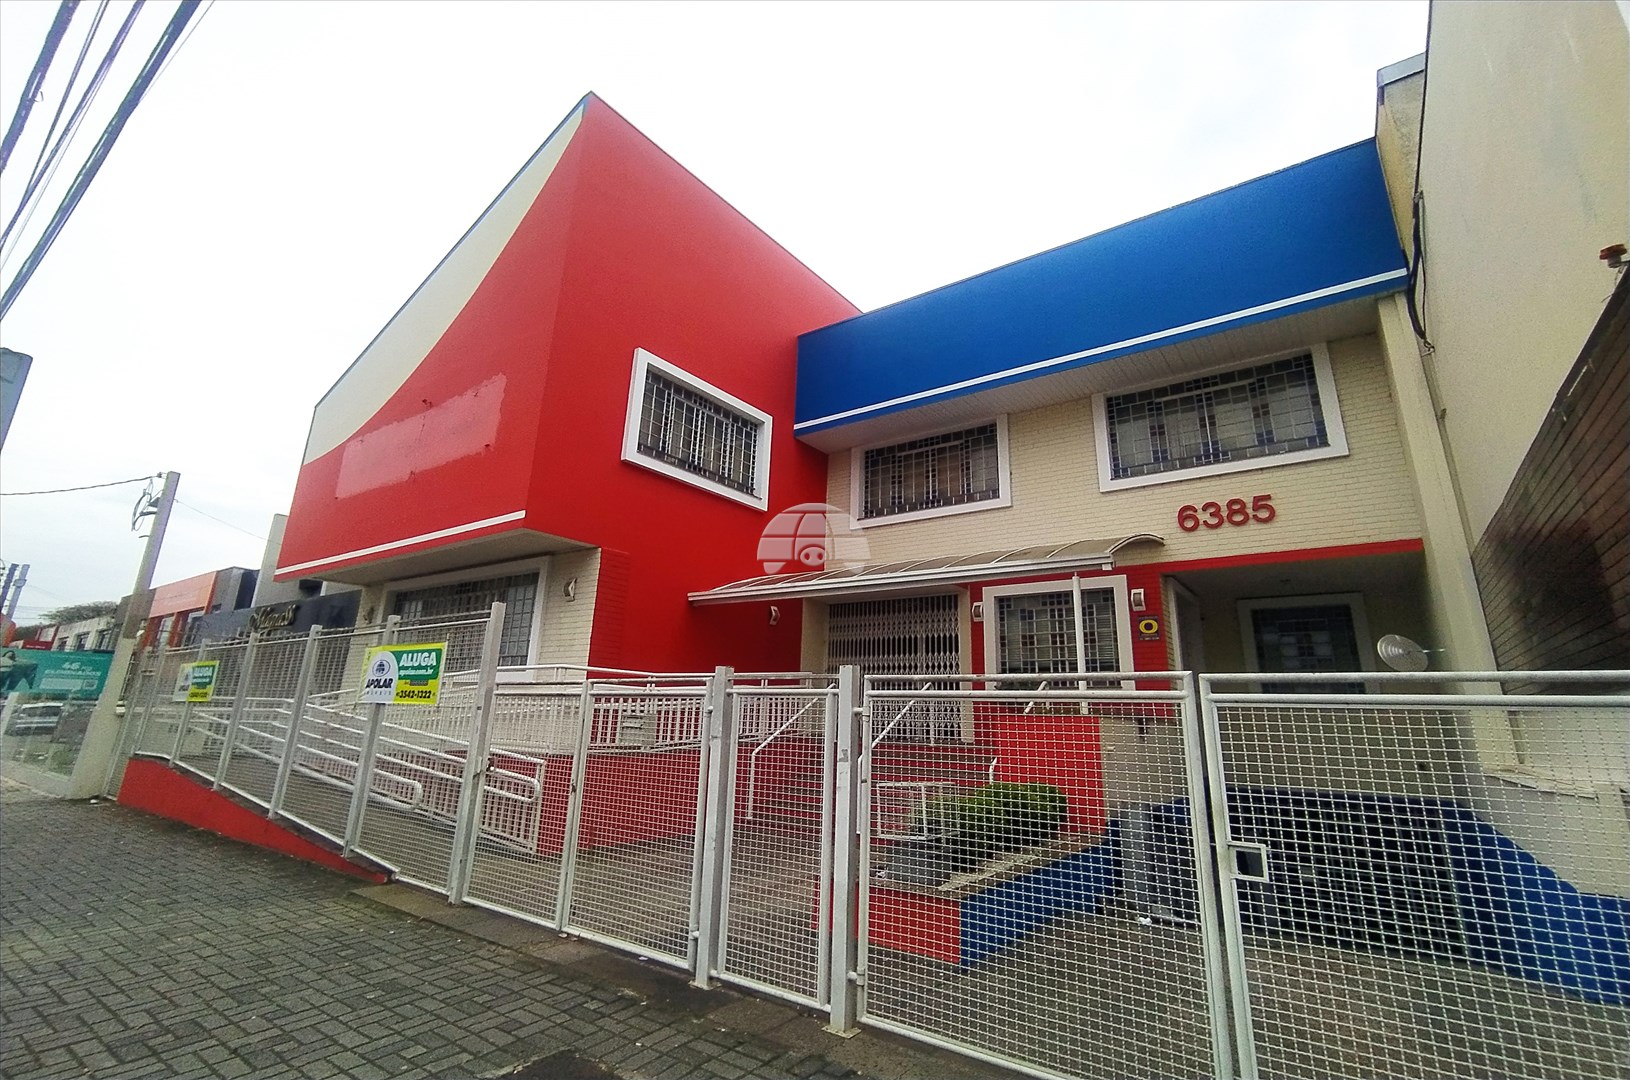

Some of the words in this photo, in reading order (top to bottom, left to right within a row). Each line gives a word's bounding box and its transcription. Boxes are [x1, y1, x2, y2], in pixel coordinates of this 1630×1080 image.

[1177, 494, 1276, 532] 6385
[399, 652, 437, 667] ALUGA
[365, 678, 393, 689] APOLAR
